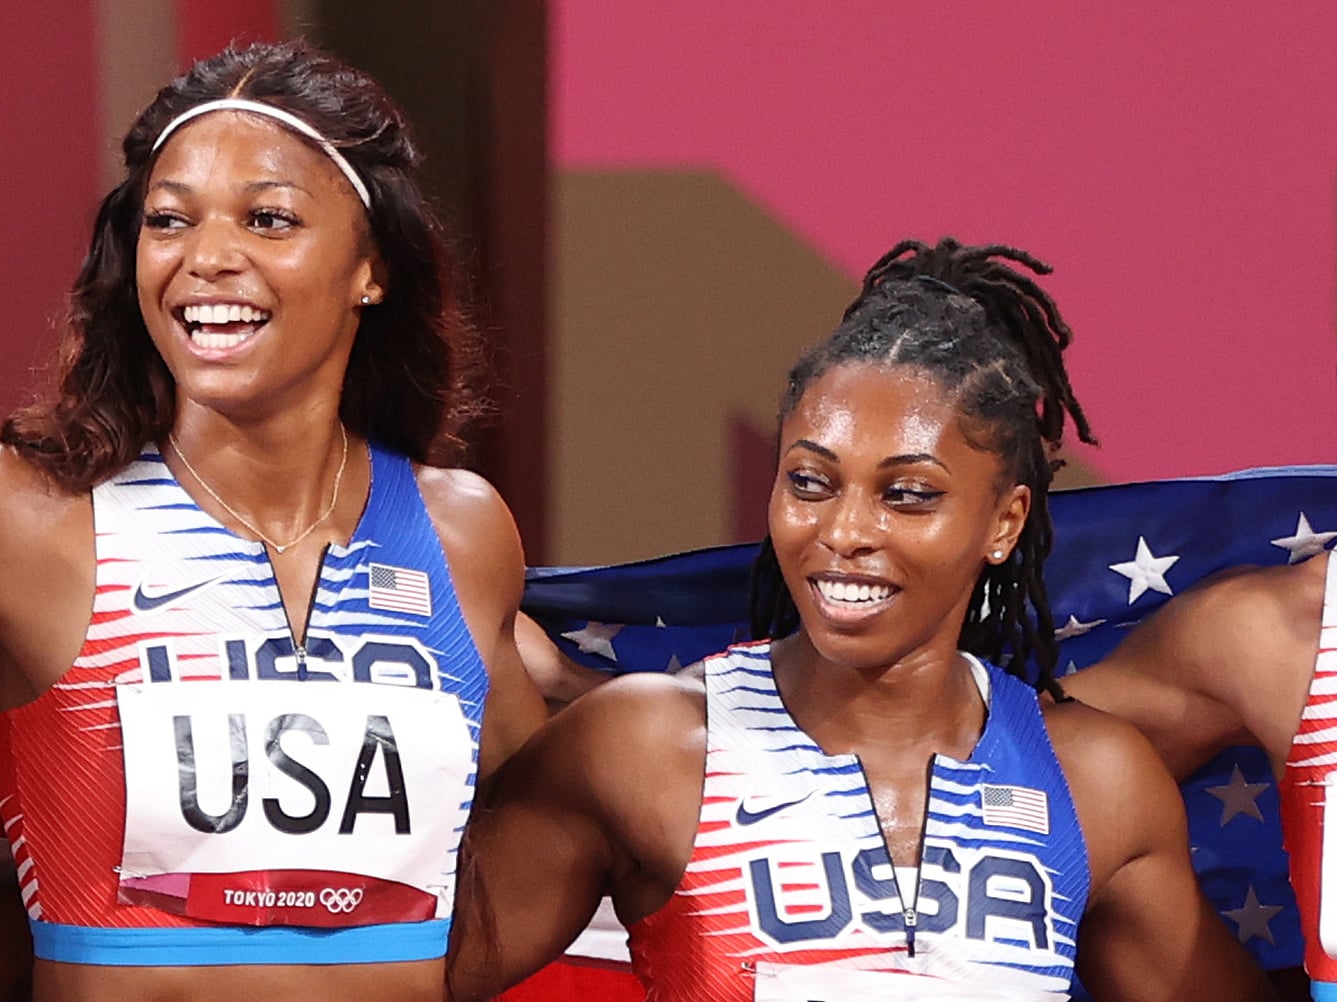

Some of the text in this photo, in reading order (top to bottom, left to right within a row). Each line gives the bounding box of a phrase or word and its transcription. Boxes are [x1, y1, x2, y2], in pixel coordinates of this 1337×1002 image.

[172, 713, 412, 835] USA
[223, 889, 315, 908] TOKYO 2020
[746, 842, 1054, 951] USA
